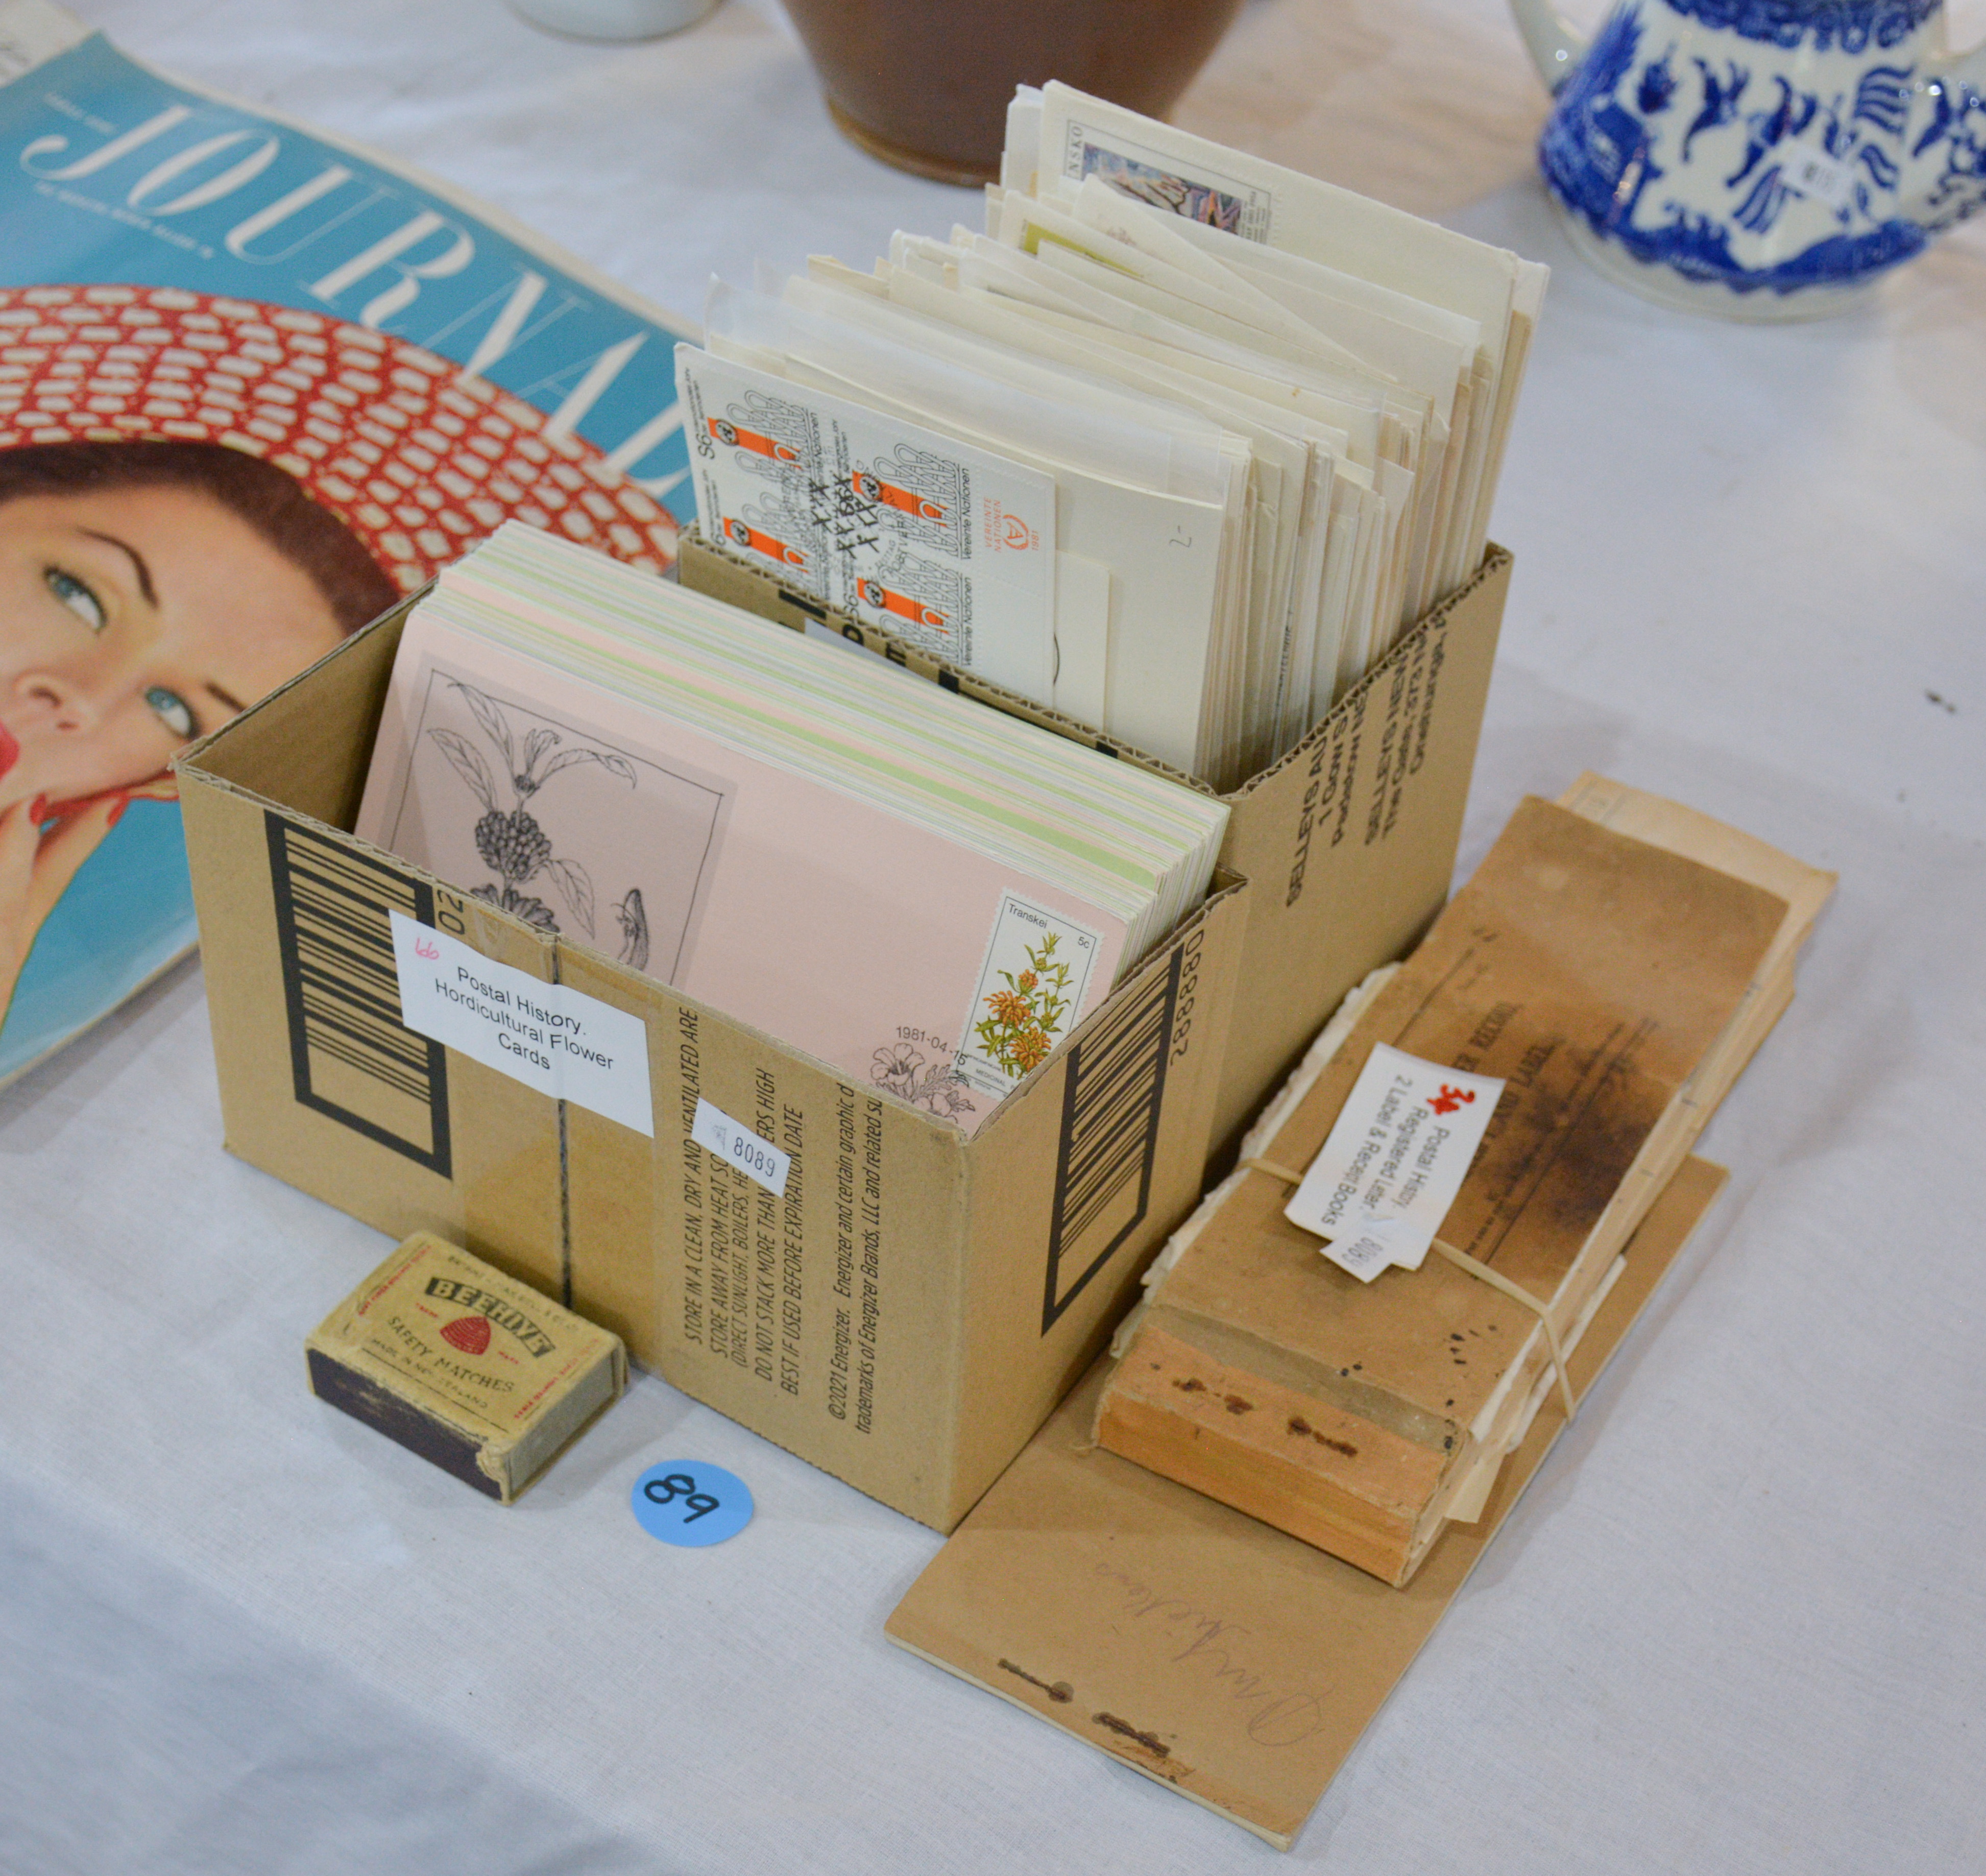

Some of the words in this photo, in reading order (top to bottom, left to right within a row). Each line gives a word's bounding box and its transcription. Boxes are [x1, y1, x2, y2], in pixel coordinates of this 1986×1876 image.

[962, 468, 971, 515] Nationen
[962, 518, 972, 560] Vereinte
[983, 496, 992, 548] VEREINTE
[993, 499, 1002, 554] NATIONEN
[1030, 529, 1040, 551] 1981
[963, 576, 973, 624] Nationen
[1286, 780, 1320, 907] SELLEYS
[1008, 903, 1049, 929] Transkei
[1077, 935, 1091, 950] 5c
[435, 977, 544, 1045] Hordicultural
[550, 1034, 614, 1070] Flower
[457, 966, 511, 1006] Postal
[517, 994, 587, 1037] History.
[498, 1032, 551, 1070] Cards
[895, 1025, 967, 1067] 1981-04-15
[680, 1044, 700, 1134] VENTILATED
[756, 1068, 775, 1111] HIGH
[1394, 1074, 1418, 1088] 2
[784, 1103, 803, 1145] DATE
[836, 1098, 856, 1155] graphic
[1378, 1086, 1408, 1128] Label
[683, 1139, 702, 1175] AND
[734, 1136, 776, 1177] 8089
[862, 1114, 882, 1169] related
[1379, 1105, 1429, 1182] Registered
[1416, 1125, 1450, 1171] Postal
[684, 1173, 702, 1209] DRY
[710, 1175, 729, 1218] HEAT
[783, 1147, 804, 1240] EXPIRATION
[835, 1155, 853, 1204] certain
[862, 1167, 881, 1199] and
[732, 1193, 749, 1250] BOILERS,
[757, 1186, 776, 1231] THAN
[834, 1201, 853, 1234] and
[861, 1197, 880, 1226] LLC
[1321, 1183, 1358, 1226] Books
[711, 1217, 729, 1264] FROM
[757, 1231, 776, 1278] MORE
[860, 1229, 881, 1279] Brands,
[685, 1264, 703, 1279] A
[685, 1277, 703, 1296] IN
[711, 1261, 729, 1311] AWAY
[783, 1238, 803, 1301] BEFORE
[833, 1232, 854, 1299] Energizer
[432, 1279, 551, 1356] BEEHIVE
[684, 1296, 703, 1345] STORE
[756, 1275, 775, 1326] STACK
[782, 1300, 802, 1340] USED
[858, 1278, 880, 1344] Energizer
[388, 1316, 432, 1358] SAFETY
[435, 1357, 515, 1393] MATCHES
[710, 1309, 729, 1359] STORE
[731, 1315, 749, 1368] (DIRECT
[755, 1323, 774, 1358] NOT
[782, 1338, 800, 1358] IF
[830, 1307, 852, 1373] Energizer.
[858, 1340, 876, 1361] of
[754, 1356, 773, 1382] DO
[780, 1356, 800, 1396] BEST
[854, 1360, 875, 1435] trademarks
[644, 1474, 719, 1523] 89
